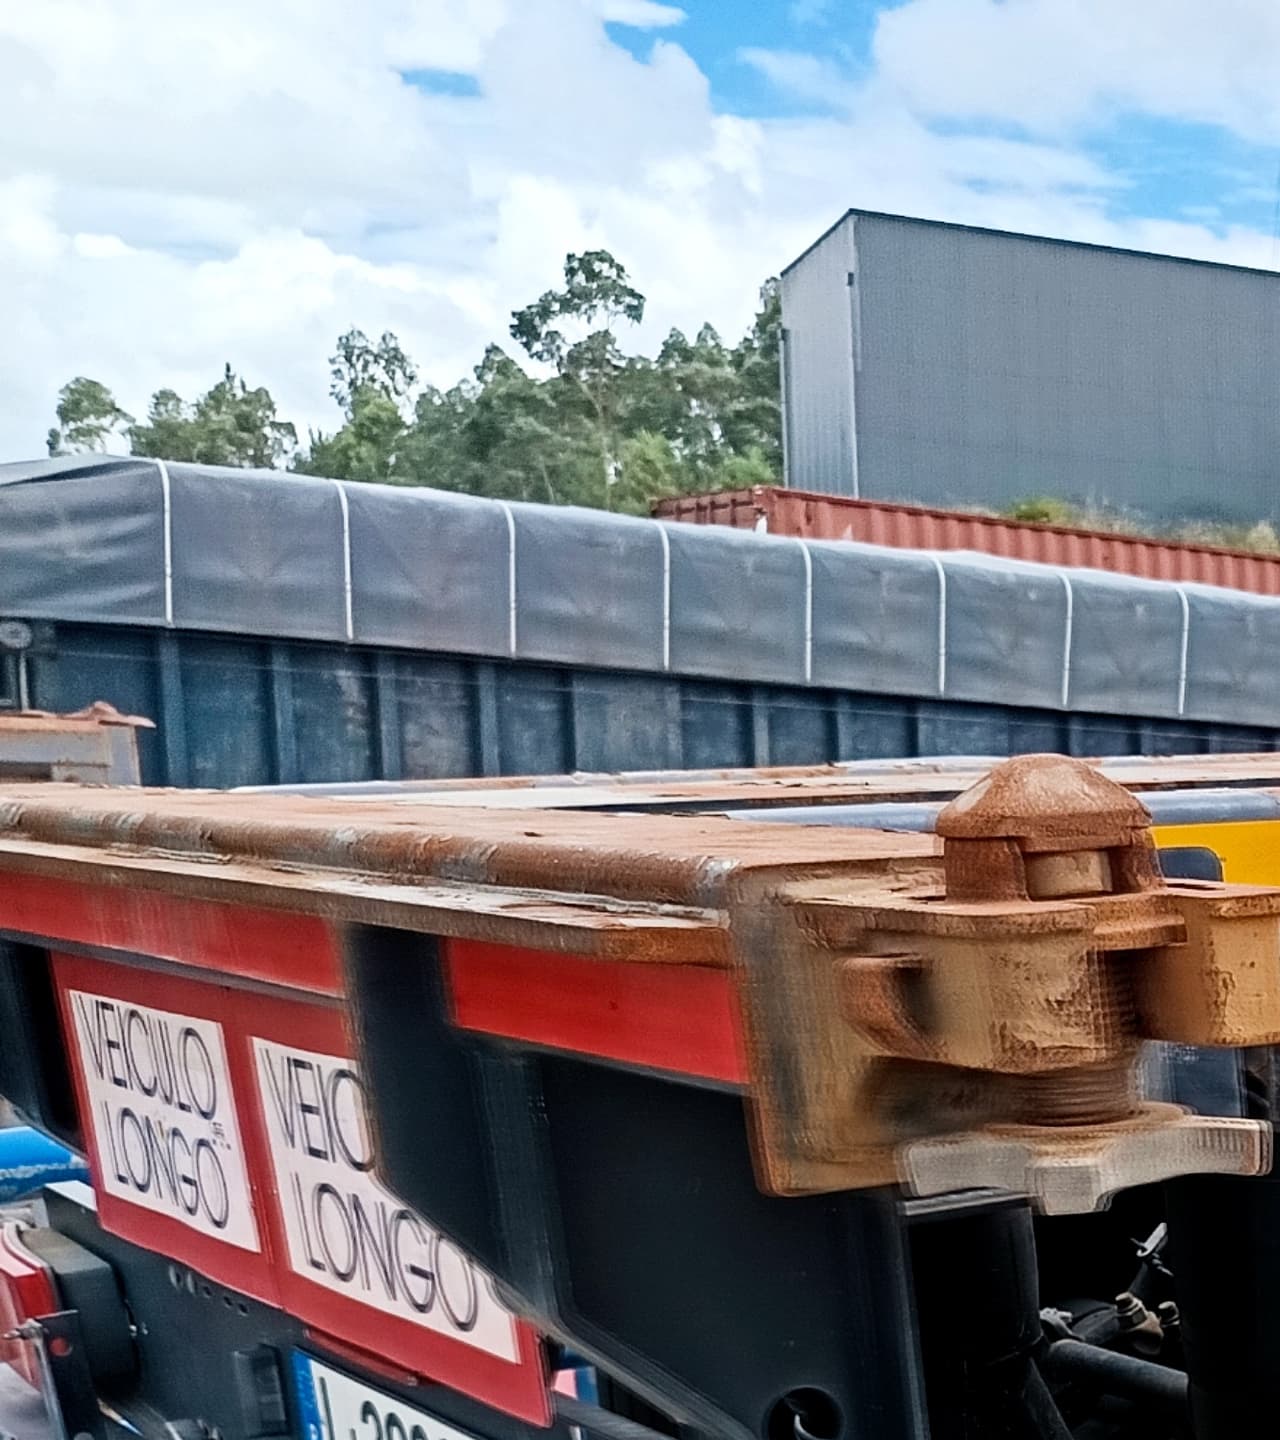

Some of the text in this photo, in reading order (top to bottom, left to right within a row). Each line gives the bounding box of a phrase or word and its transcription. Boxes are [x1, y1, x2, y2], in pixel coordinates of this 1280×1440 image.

[79, 992, 218, 1121] VEICULO
[261, 1043, 376, 1172] VEIC
[101, 1100, 229, 1230] LONGO
[294, 1172, 478, 1332] LONGO
